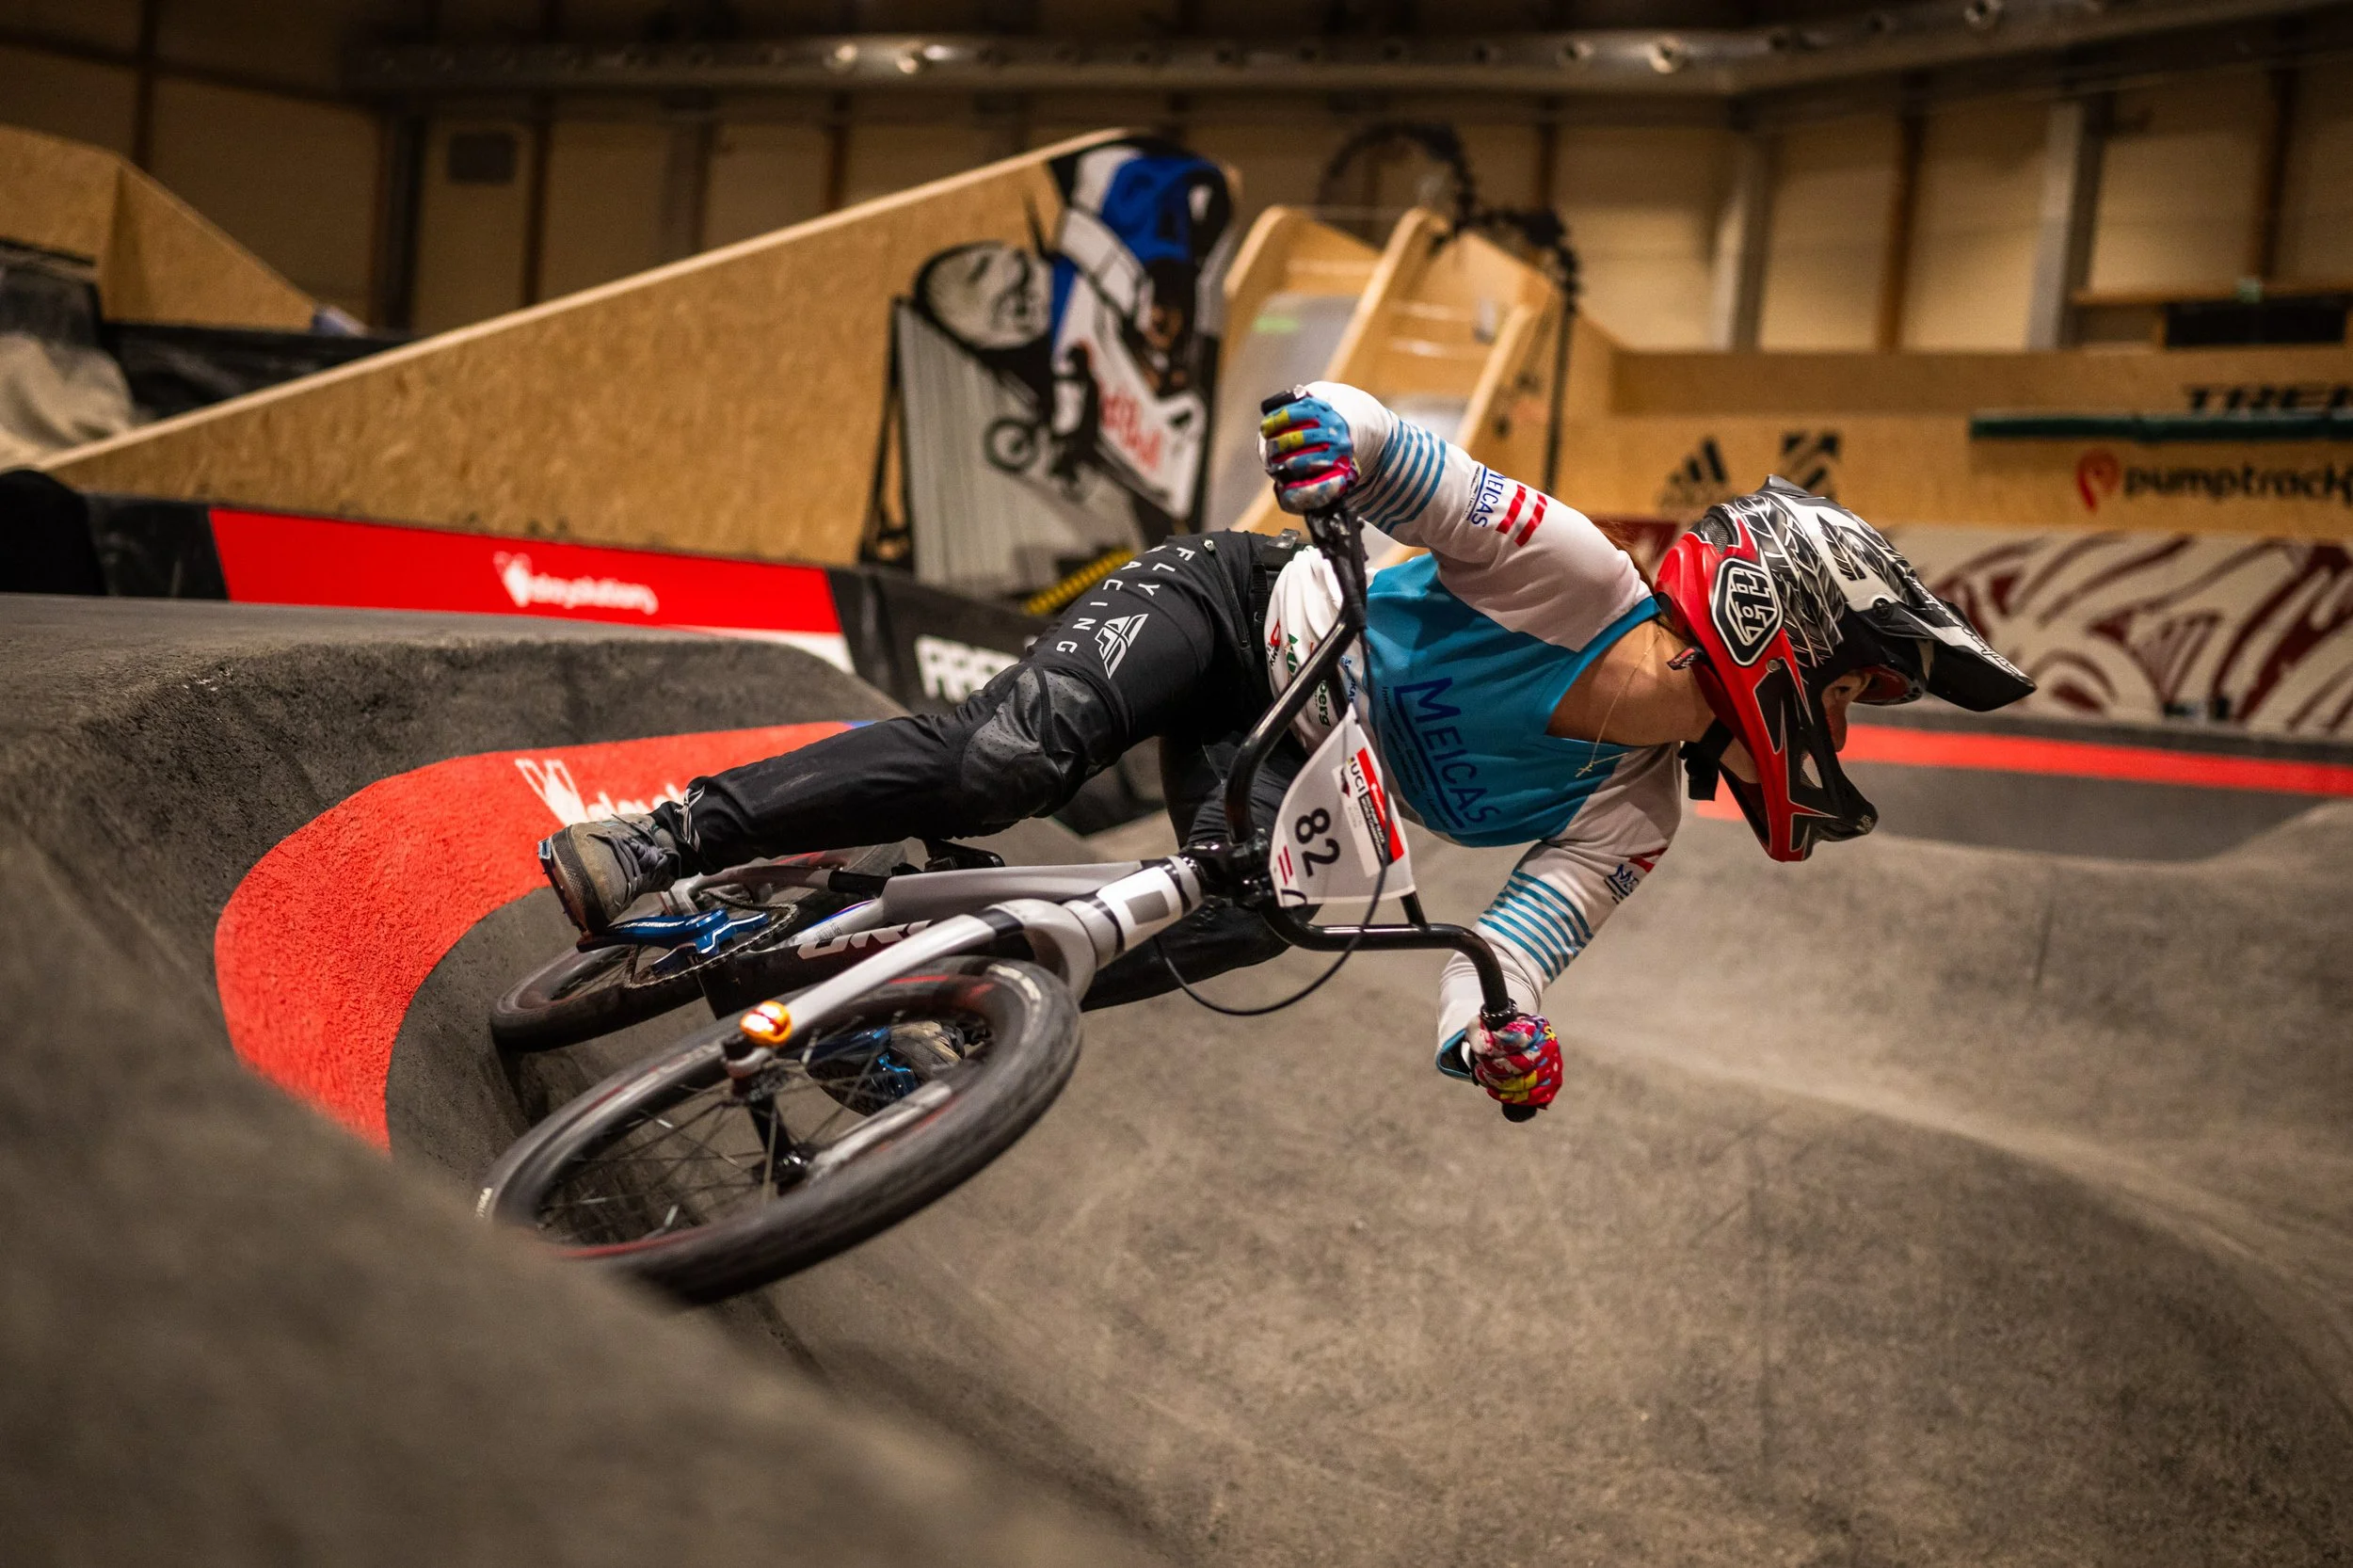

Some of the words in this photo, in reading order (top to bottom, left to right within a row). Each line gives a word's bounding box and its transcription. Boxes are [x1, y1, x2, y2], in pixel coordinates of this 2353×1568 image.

[1137, 547, 1196, 598] FLY
[1350, 762, 1367, 793] UCI
[1394, 677, 1502, 824] MEICAS
[1294, 808, 1340, 877] 82
